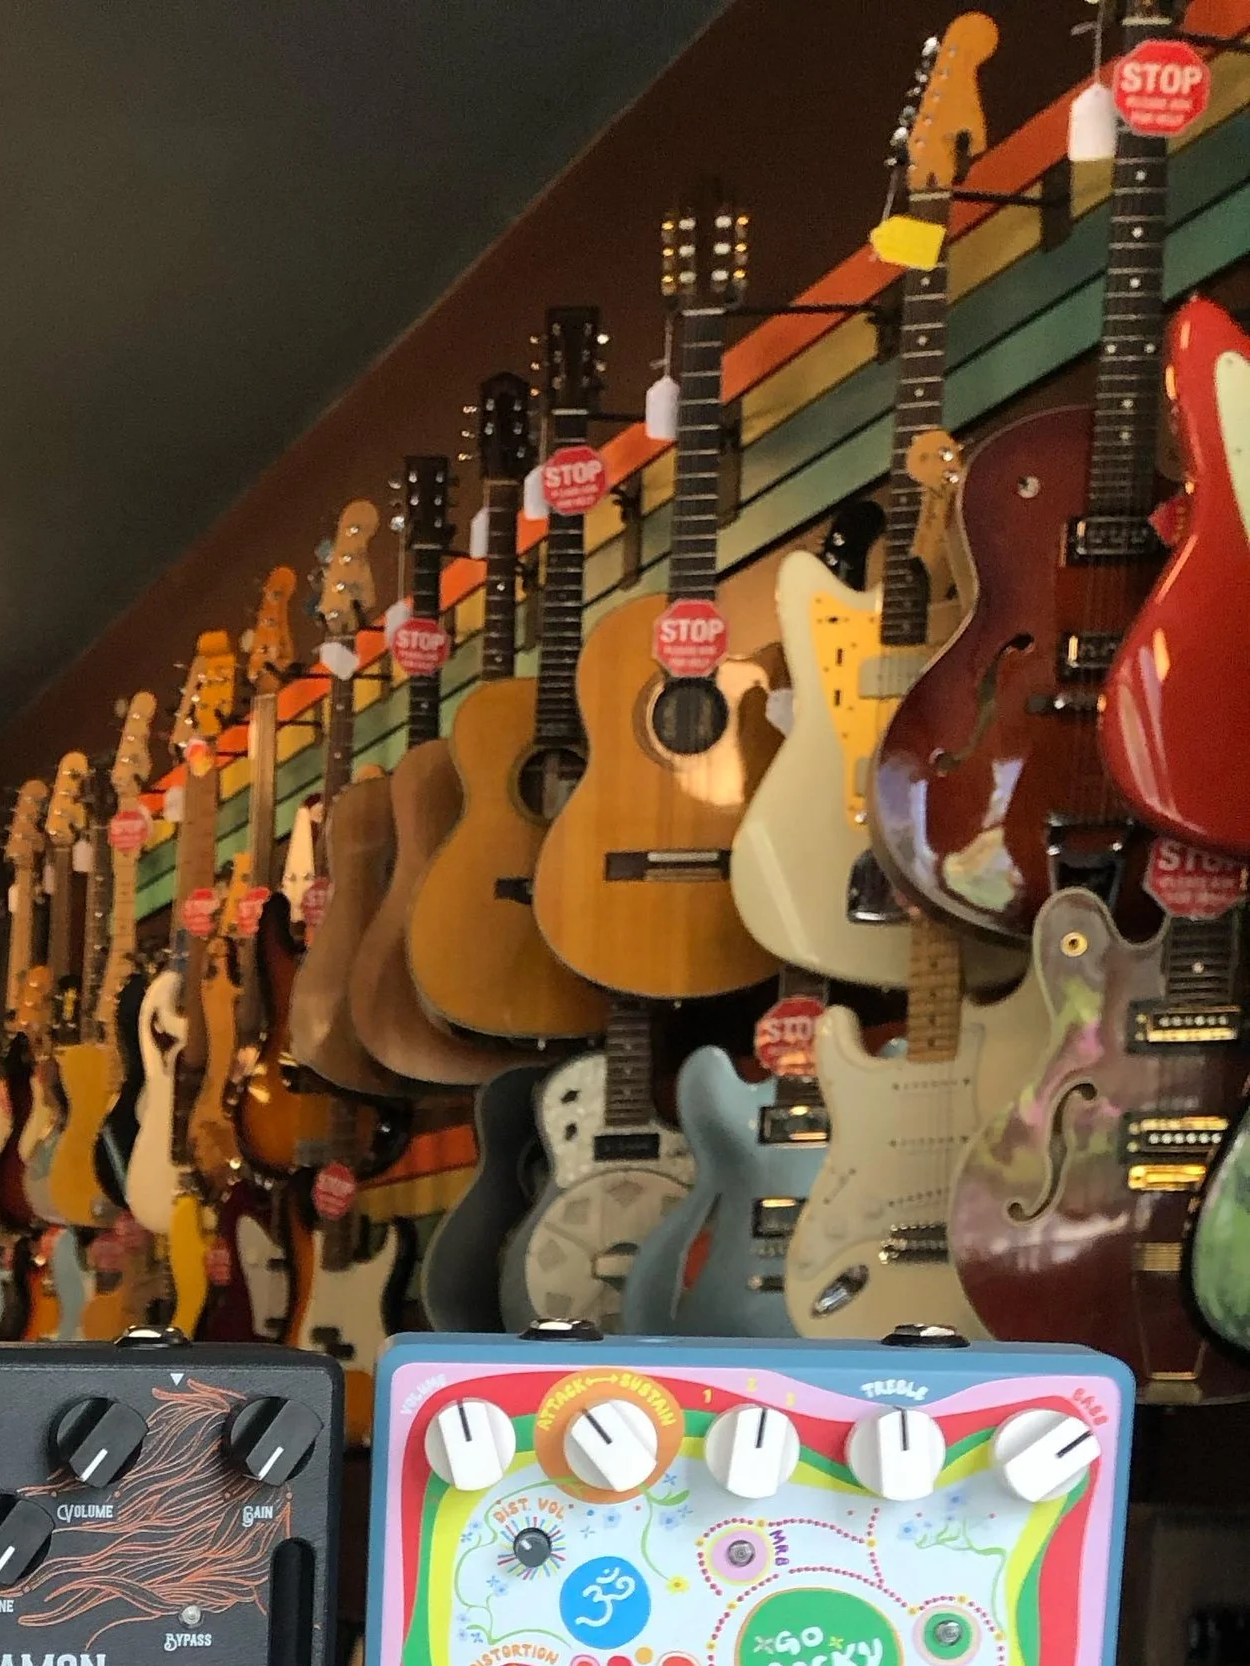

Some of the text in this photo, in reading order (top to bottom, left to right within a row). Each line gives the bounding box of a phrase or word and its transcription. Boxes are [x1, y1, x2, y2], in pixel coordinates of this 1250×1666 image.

[1120, 61, 1203, 95] STOP
[545, 460, 602, 488] STOP
[395, 629, 445, 651] STOP
[660, 618, 725, 643] STOP
[400, 1373, 447, 1416] VOLUME
[536, 1373, 677, 1431] ATTACK SUSTAIN
[702, 1389, 713, 1404] 1
[860, 1379, 929, 1401] TREBLE
[1072, 1387, 1109, 1426] BASS
[769, 1529, 790, 1566] MRB
[775, 1626, 824, 1655] GO
